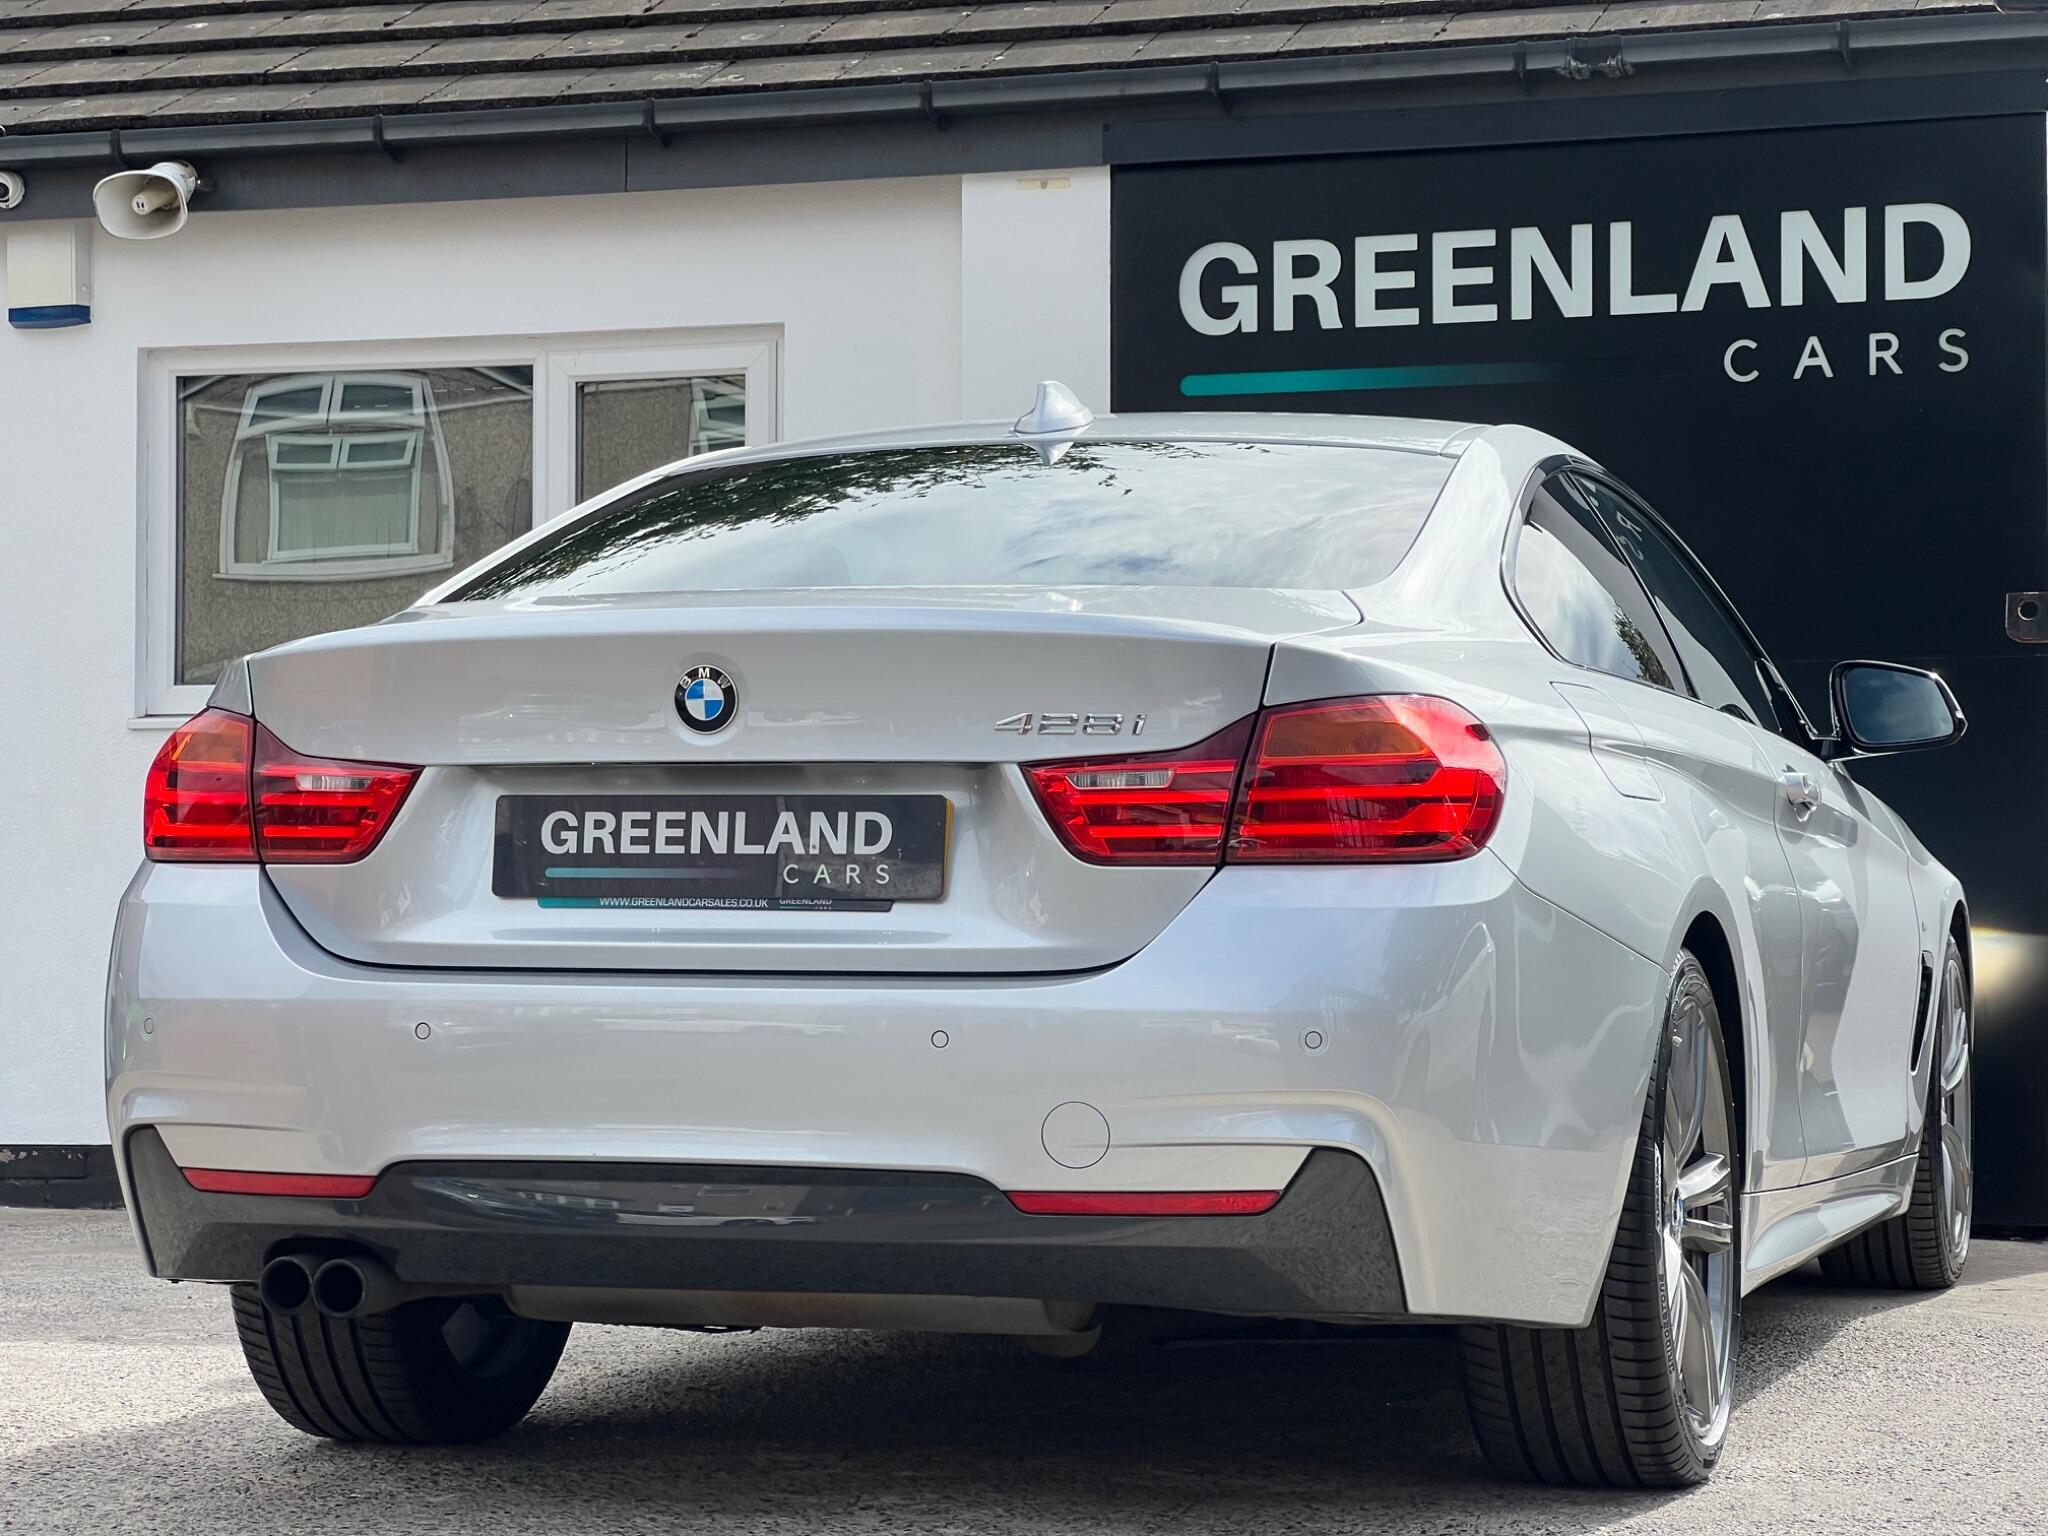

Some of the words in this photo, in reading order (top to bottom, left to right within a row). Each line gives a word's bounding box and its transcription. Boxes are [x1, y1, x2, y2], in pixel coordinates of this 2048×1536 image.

[1178, 202, 1972, 336] GREENLAND
[1723, 328, 1970, 383] CARS
[680, 667, 731, 689] BMW
[994, 712, 1147, 736] 428i
[540, 810, 893, 855] GREENLAND
[782, 863, 890, 885] CARS
[600, 897, 769, 908] WWW.GREENLANDCARSALES.CO.UK
